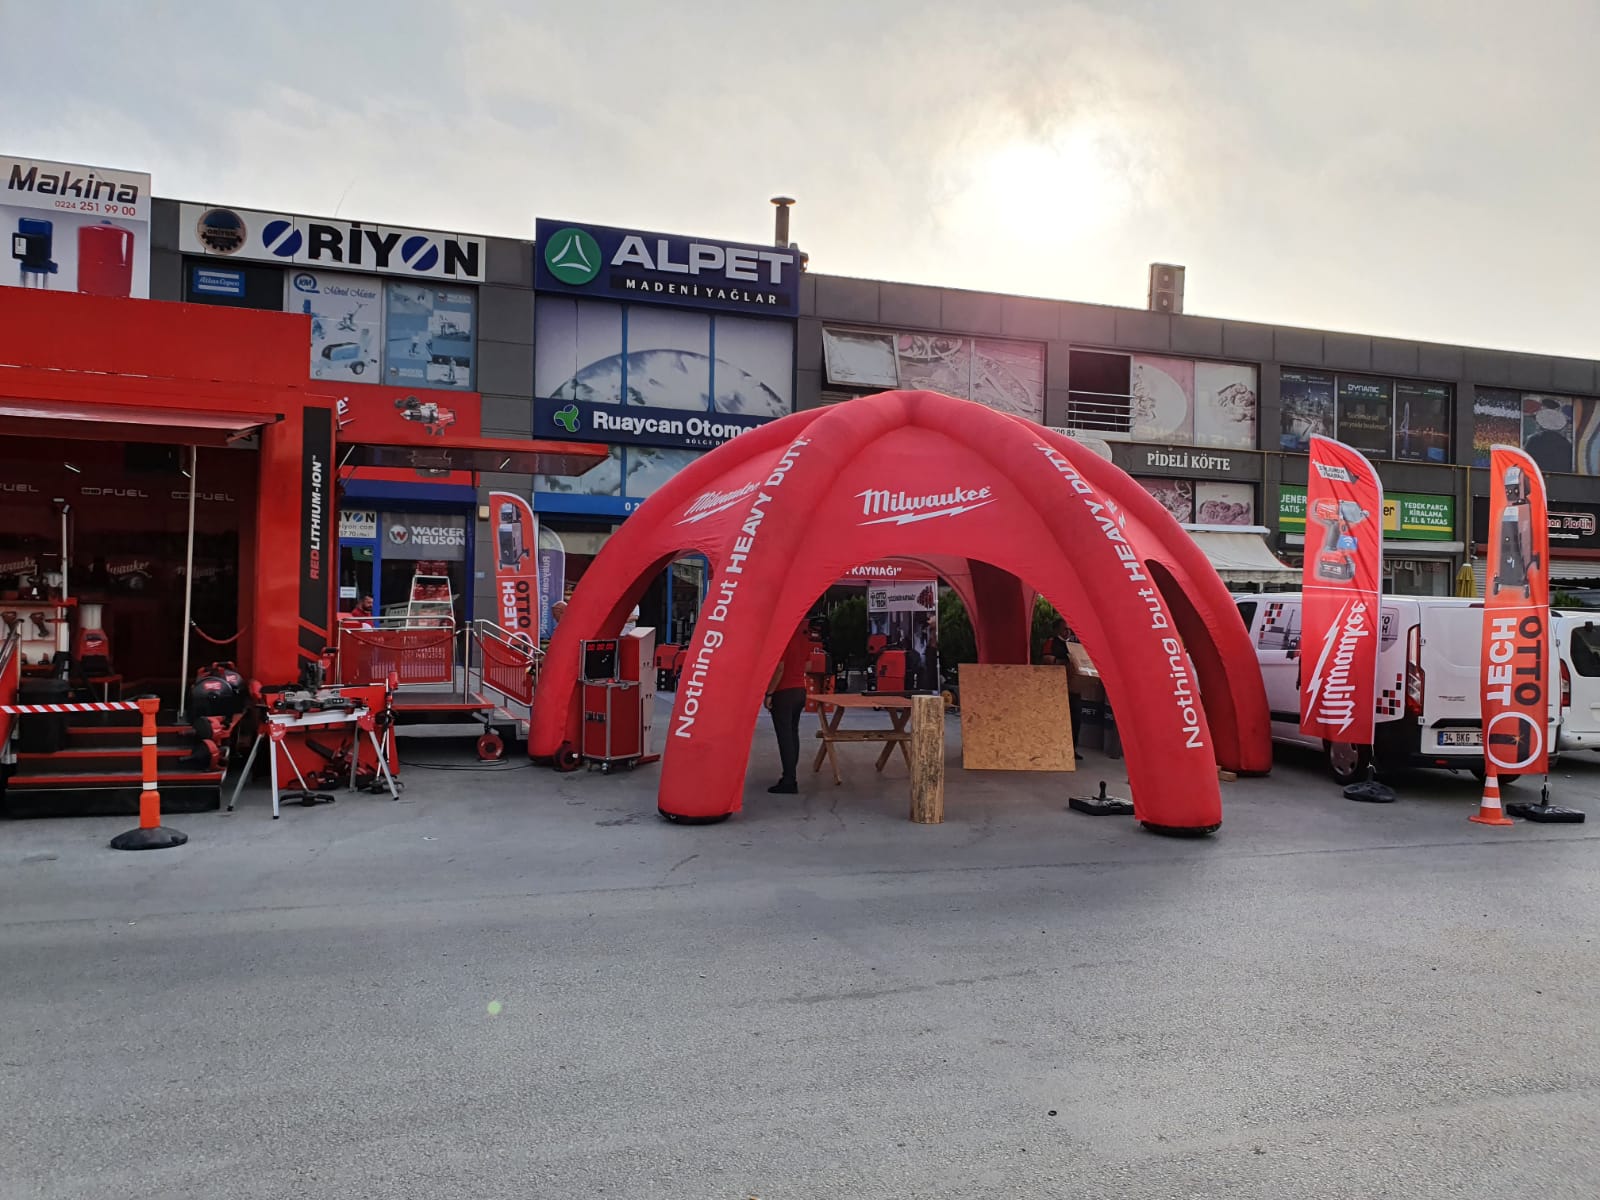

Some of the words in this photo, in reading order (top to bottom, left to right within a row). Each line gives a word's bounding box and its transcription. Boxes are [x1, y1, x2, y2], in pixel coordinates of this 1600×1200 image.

[8, 164, 139, 204] Makina
[55, 200, 76, 209] 0224
[79, 201, 100, 211] 251
[104, 204, 119, 214] 99
[121, 206, 136, 216] 00
[610, 235, 794, 284] ALPET
[626, 279, 698, 296] MADENİ
[706, 288, 777, 305] YAĞLAR
[593, 411, 683, 434] Ruaycan
[1147, 452, 1188, 468] PİDELİ
[1191, 454, 1230, 471] KÖFTE
[854, 484, 993, 517] Milwaukee
[1279, 504, 1300, 514] SATIŞ
[1280, 494, 1307, 504] JENER
[1404, 502, 1426, 510] YEDEK
[1426, 503, 1448, 511] PARÇA
[411, 526, 465, 537] WACKER
[1427, 518, 1448, 526] TAKAS
[411, 535, 465, 546] NEUSON
[1083, 499, 1147, 582] HEAVY
[675, 629, 724, 738] Nothing
[708, 579, 738, 622] but
[725, 491, 772, 574] HEAVY
[1138, 587, 1168, 629] but
[1161, 638, 1204, 749] Nothing
[1444, 733, 1453, 742] 34
[1456, 733, 1470, 742] BKG
